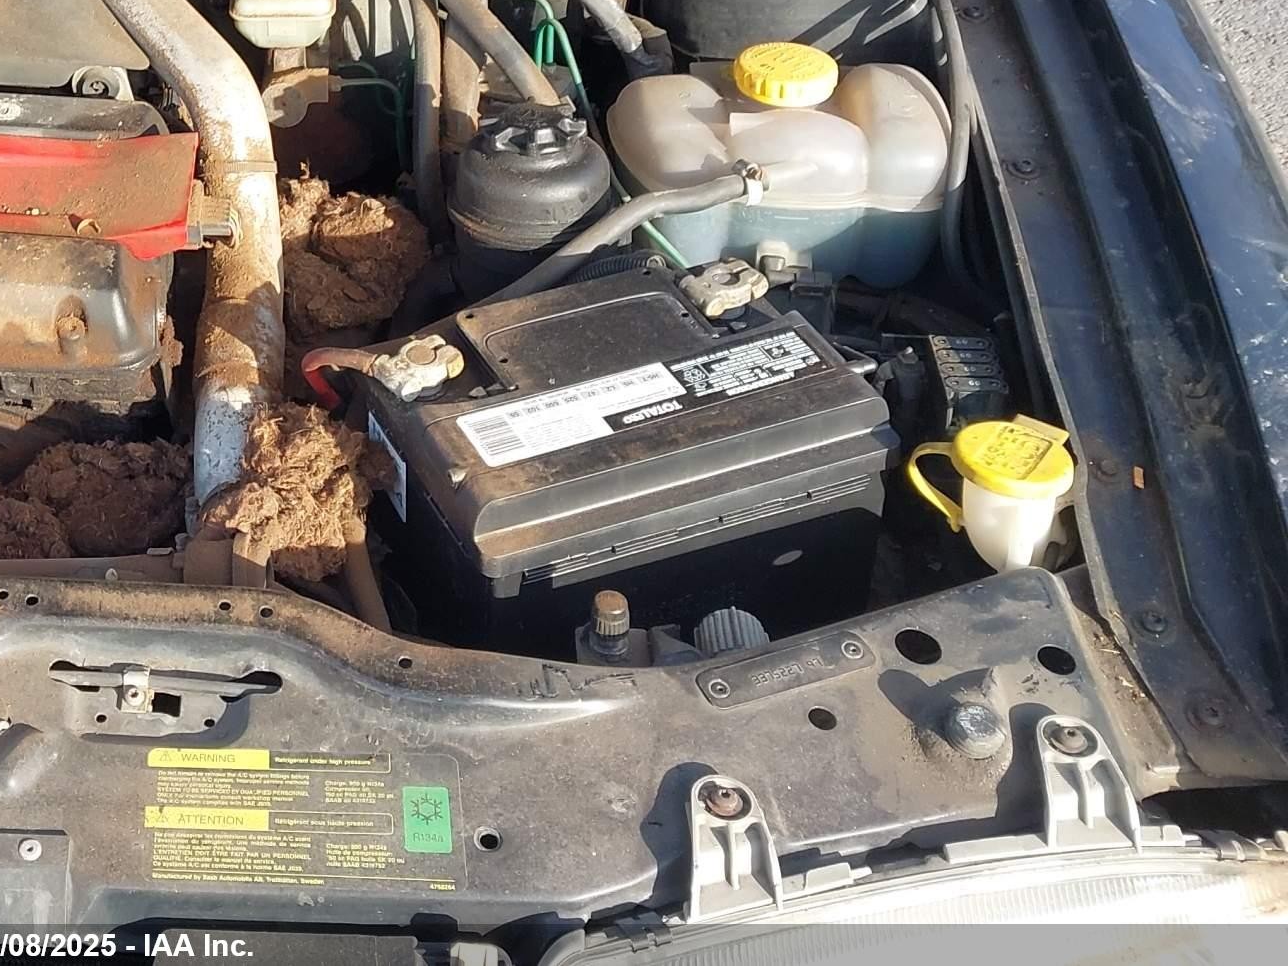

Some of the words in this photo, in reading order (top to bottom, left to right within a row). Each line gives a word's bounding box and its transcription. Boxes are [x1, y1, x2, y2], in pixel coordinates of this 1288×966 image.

[181, 753, 236, 764] WARNING
[329, 758, 343, 767] high
[344, 759, 371, 768] pressure
[178, 814, 244, 825] ATTENTION
[346, 820, 374, 829] pression
[413, 832, 444, 844] R134a
[272, 853, 312, 861] PERSONNEL
[152, 872, 193, 881] Manufactured
[193, 873, 202, 882] by
[219, 875, 252, 883] Automobile
[300, 877, 325, 886] Sweden
